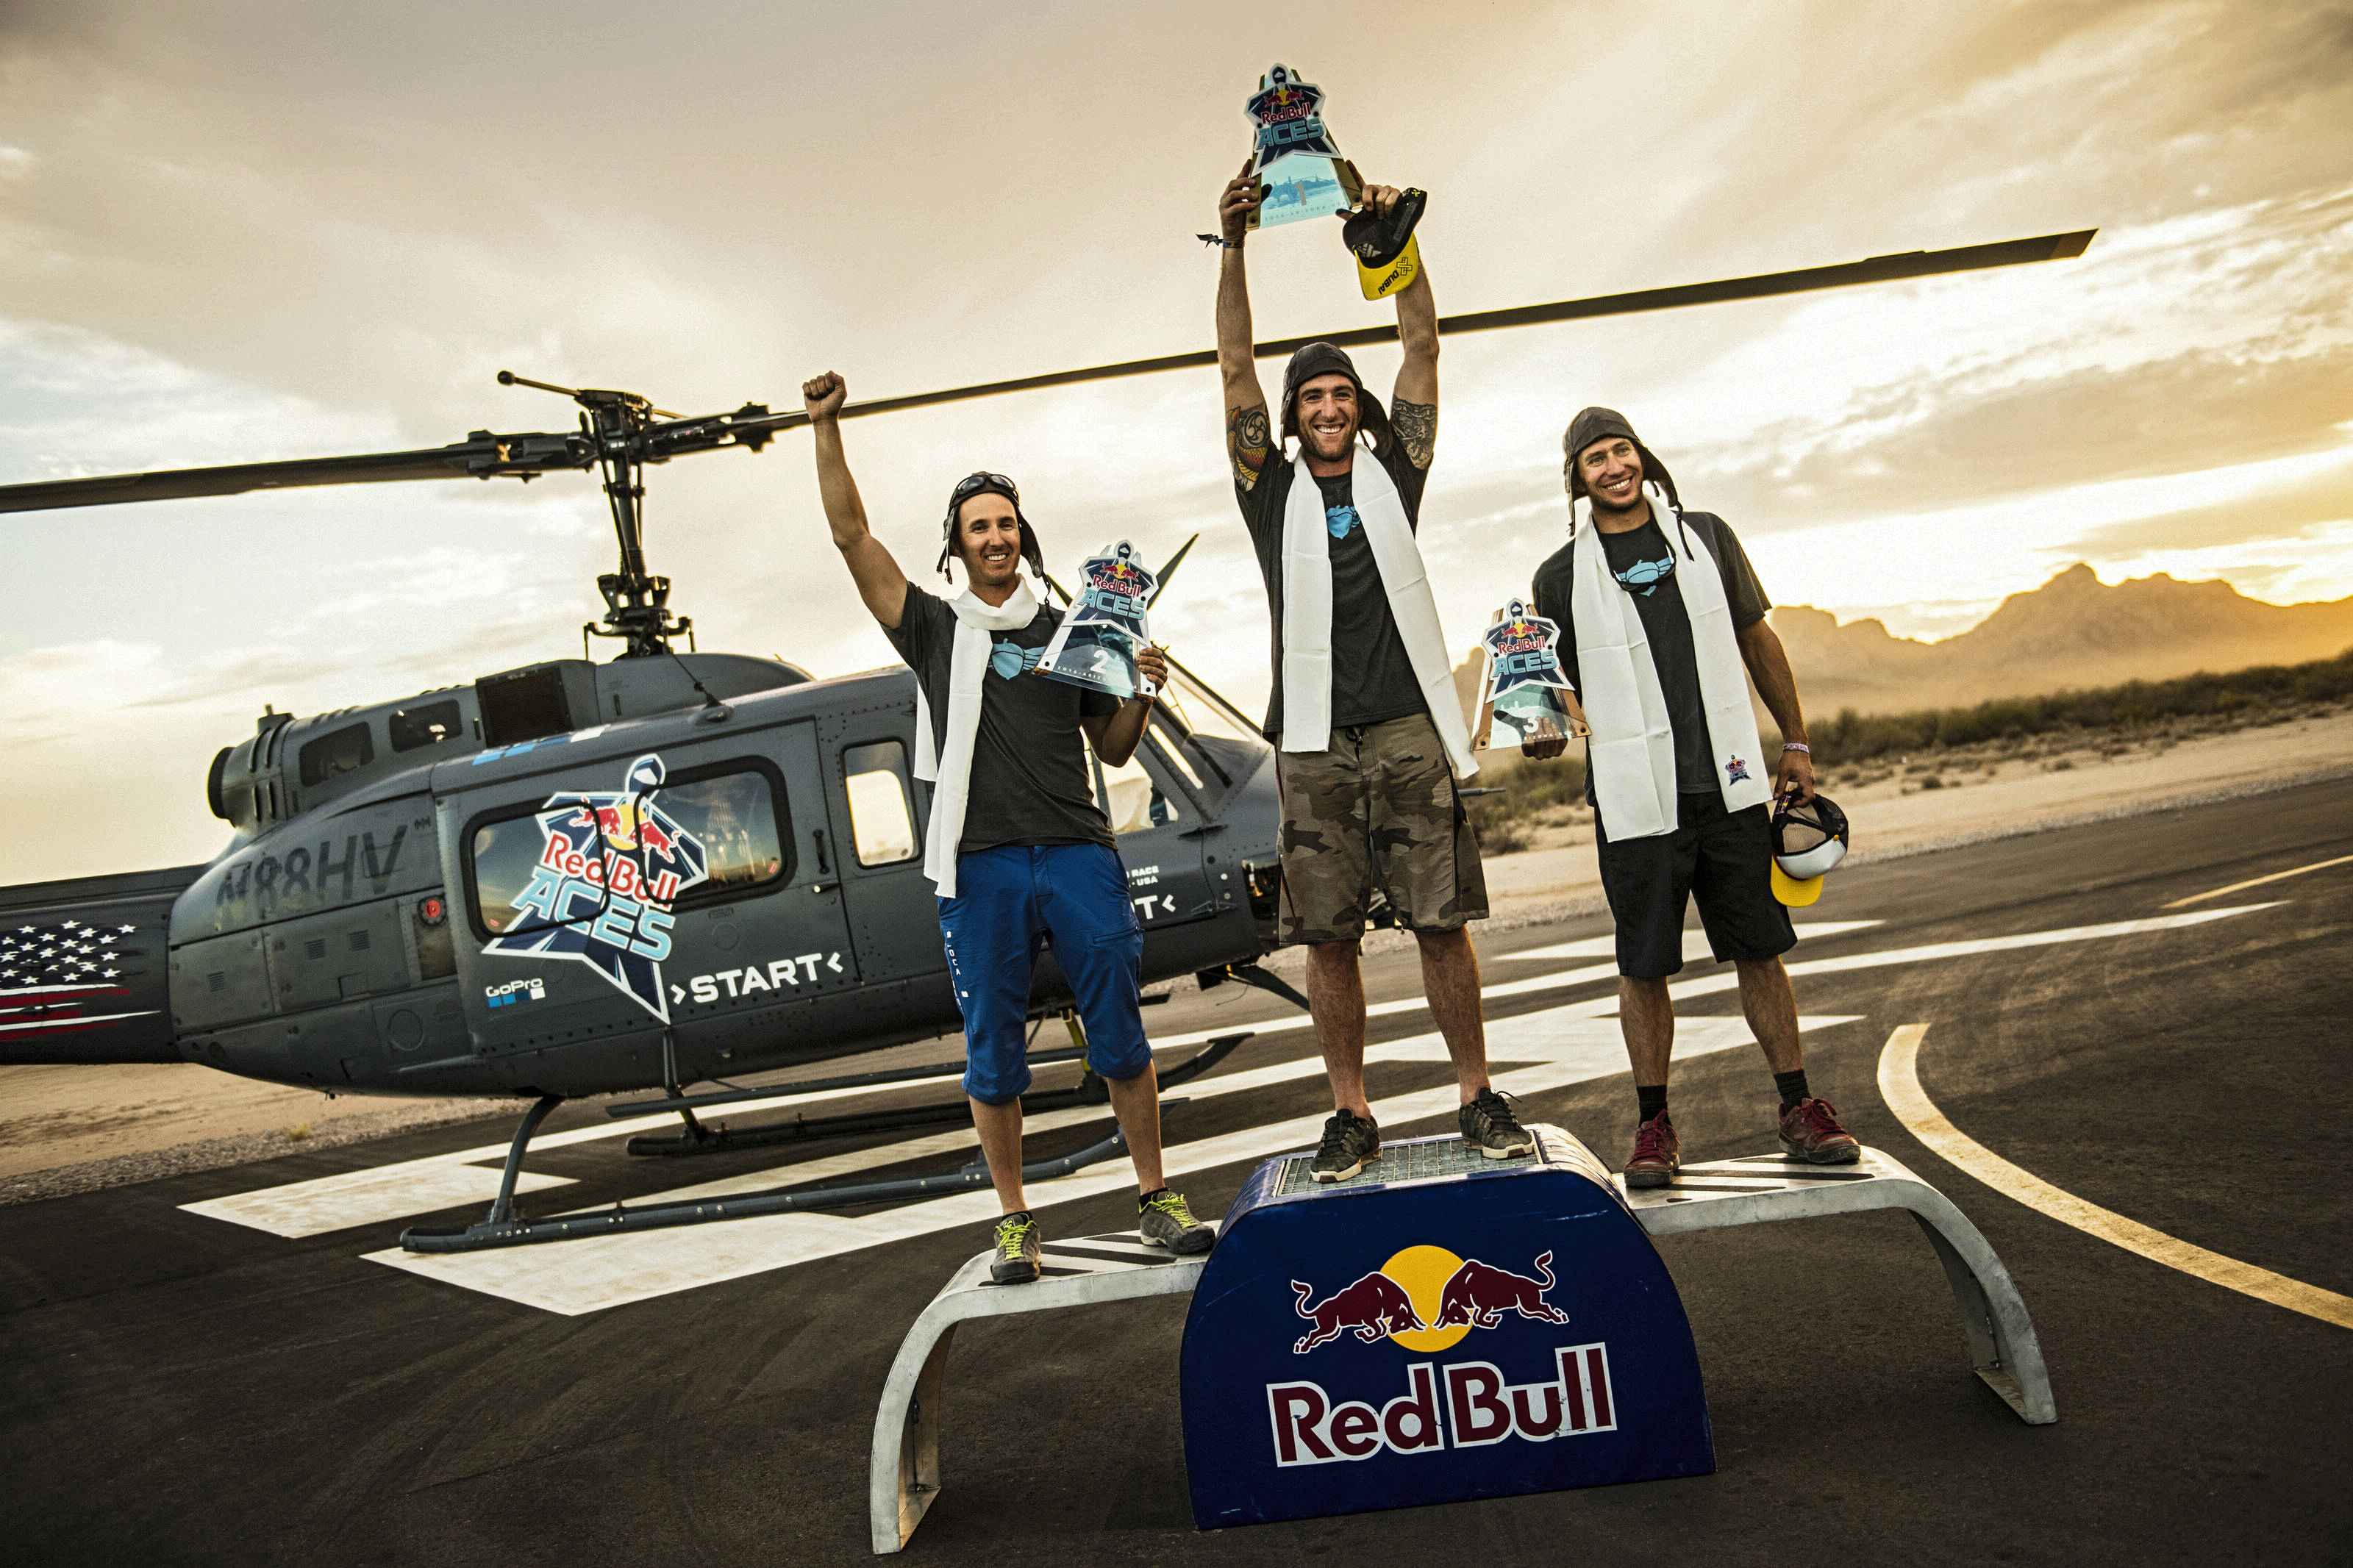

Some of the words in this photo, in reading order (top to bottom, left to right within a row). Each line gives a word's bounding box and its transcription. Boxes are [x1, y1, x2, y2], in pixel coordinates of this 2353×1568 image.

[1261, 107, 1287, 123] Red
[1287, 101, 1311, 119] Bull
[1258, 118, 1324, 148] ACES
[1377, 270, 1400, 295] DUBAI
[1093, 575, 1117, 592] Red
[1117, 579, 1142, 597] Bull
[1079, 588, 1146, 620] ACES
[1497, 640, 1524, 654] Red
[1521, 636, 1546, 651] Bull
[1090, 650, 1108, 674] 2
[1493, 651, 1557, 676] ACES
[539, 829, 613, 884] Red
[607, 849, 682, 910] Bull
[1131, 865, 1160, 877] RACE
[1136, 876, 1158, 886] USA
[510, 864, 676, 962] ACES
[485, 977, 543, 998] GoPro
[690, 953, 824, 1003] START
[1265, 1361, 1445, 1468] Red
[1442, 1342, 1618, 1450] Bull
